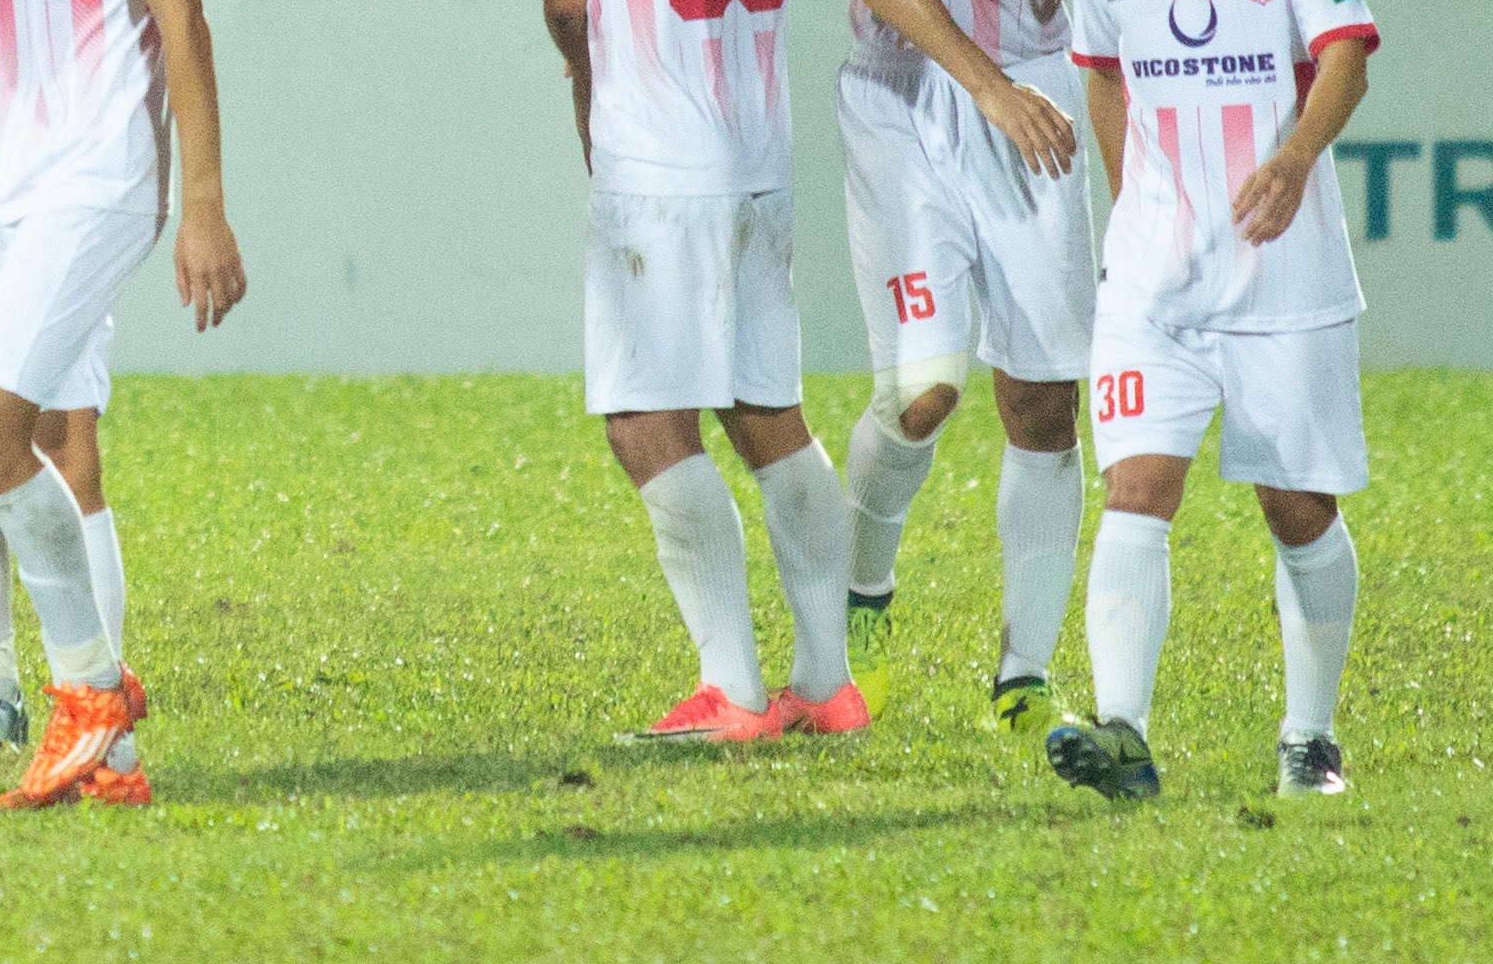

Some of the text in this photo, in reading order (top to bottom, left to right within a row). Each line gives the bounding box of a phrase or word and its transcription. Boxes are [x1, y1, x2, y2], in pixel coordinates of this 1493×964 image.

[1131, 52, 1275, 79] VICOSTONE
[886, 270, 936, 324] 15
[1096, 369, 1146, 424] 30
